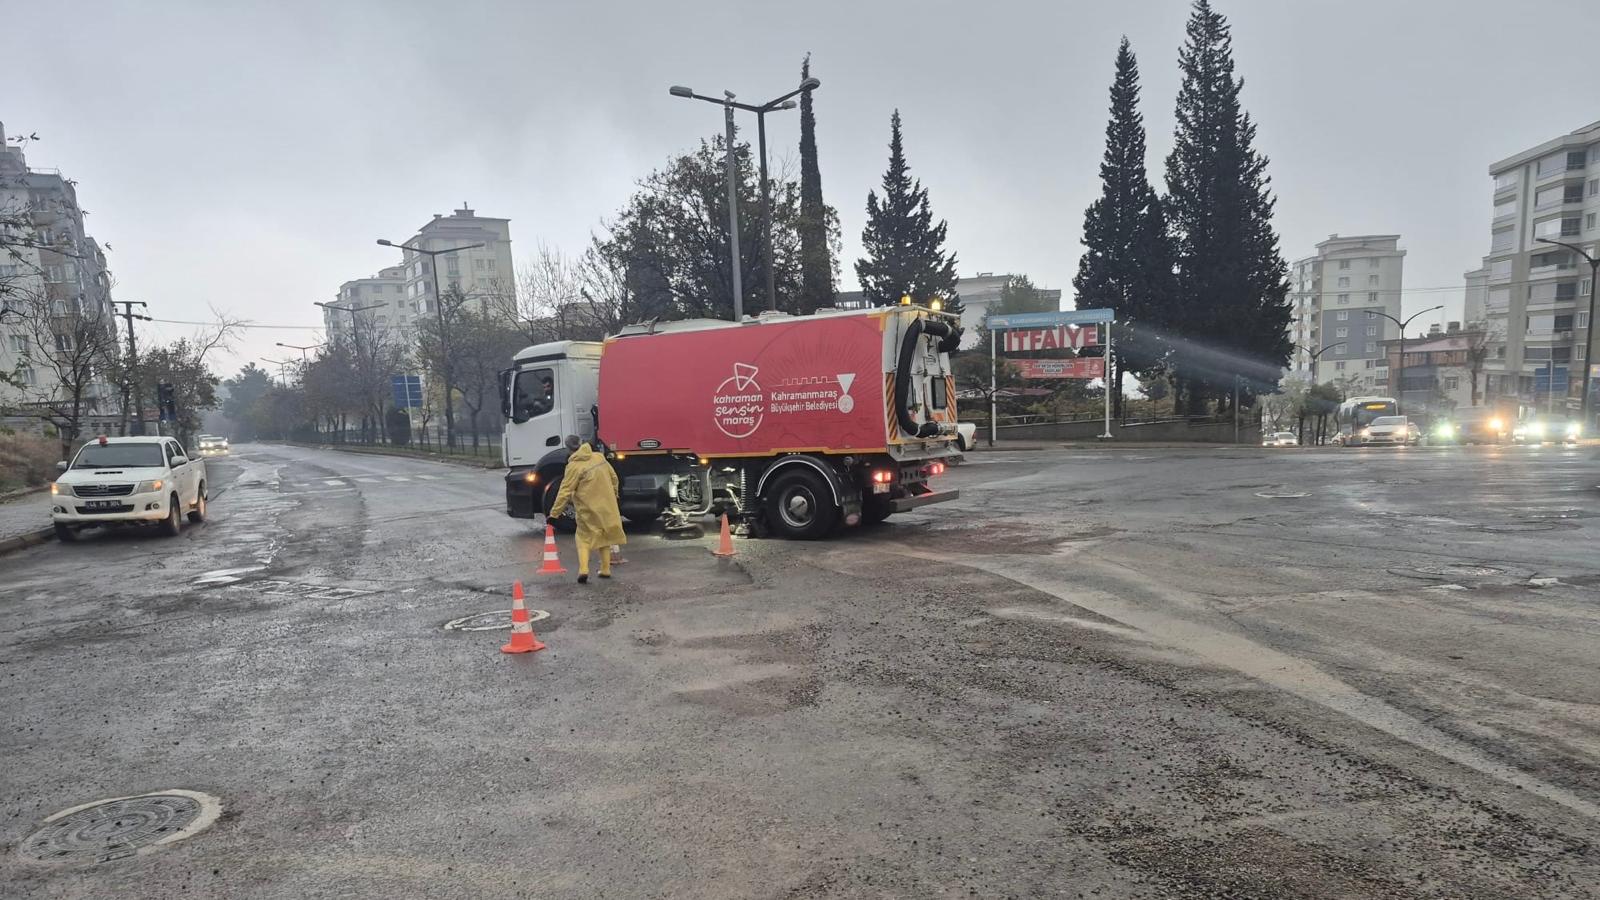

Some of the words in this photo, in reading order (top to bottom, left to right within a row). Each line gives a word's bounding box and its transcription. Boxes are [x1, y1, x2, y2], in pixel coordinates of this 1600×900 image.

[713, 394, 763, 404] kahraman
[771, 390, 838, 401] Kahramanmaraş
[715, 403, 764, 416] sensin
[770, 402, 804, 413] Büyükşehir
[805, 400, 838, 411] Belediyesi
[722, 416, 755, 426] maraş
